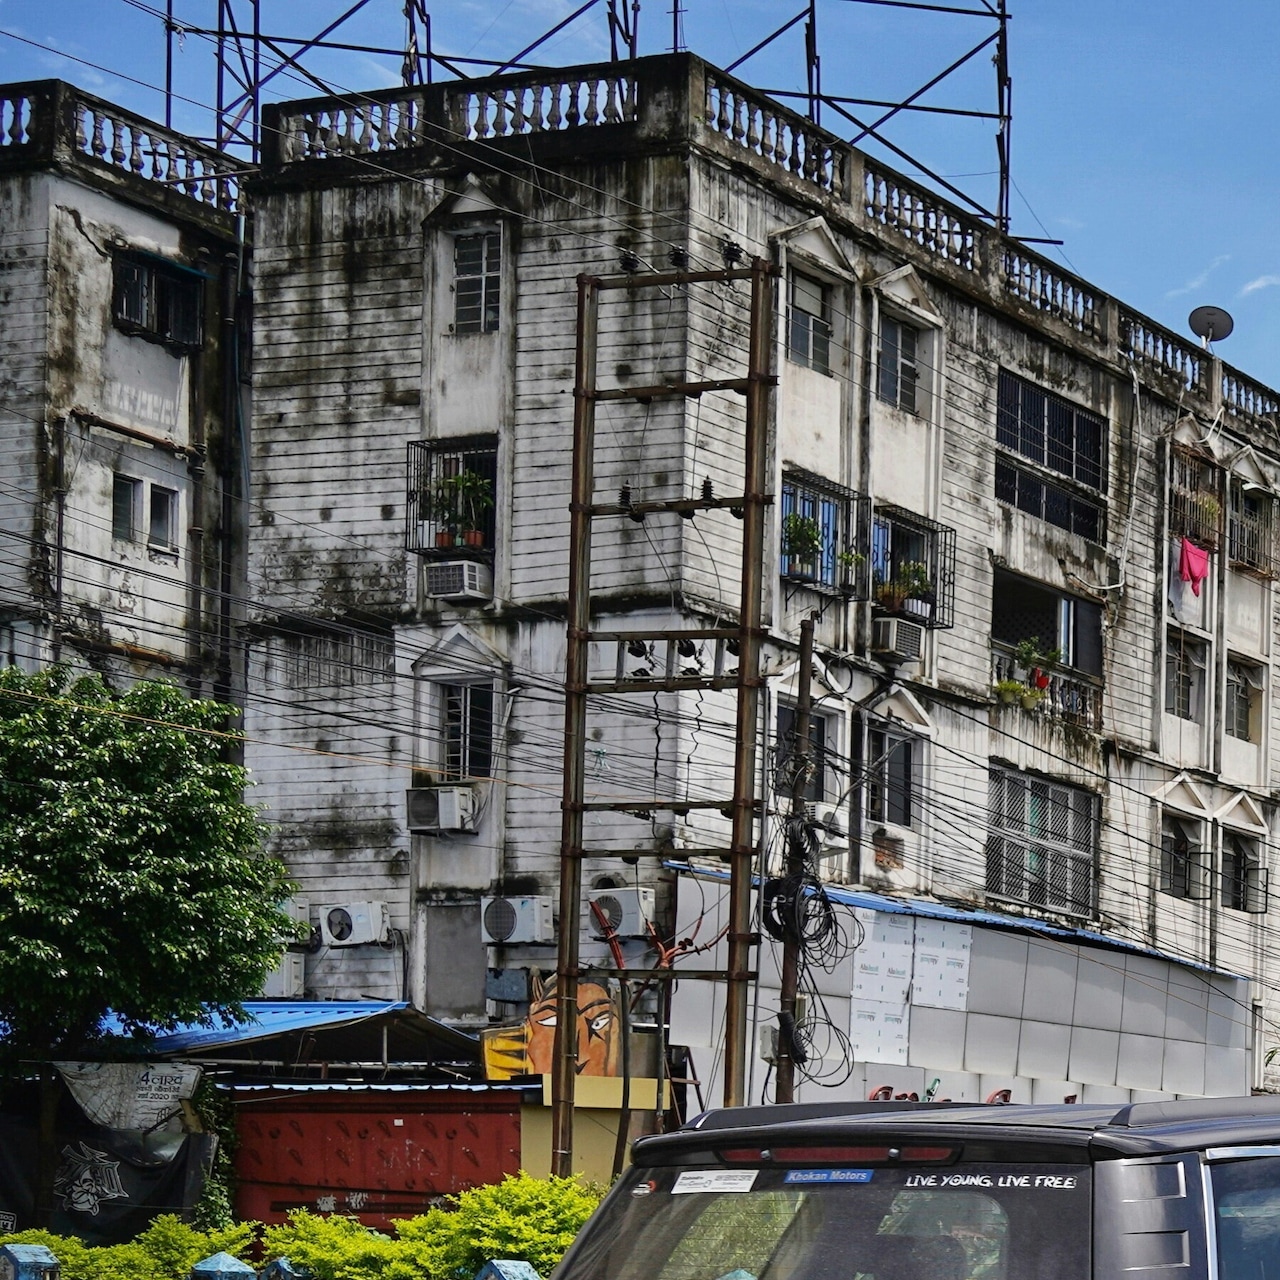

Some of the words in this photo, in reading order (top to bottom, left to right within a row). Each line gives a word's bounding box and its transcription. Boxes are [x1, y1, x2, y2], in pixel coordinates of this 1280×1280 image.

[788, 1169, 828, 1181] Khokan
[831, 1168, 867, 1180] Motors
[905, 1174, 937, 1187] LIVE
[998, 1175, 1030, 1187] LIVE
